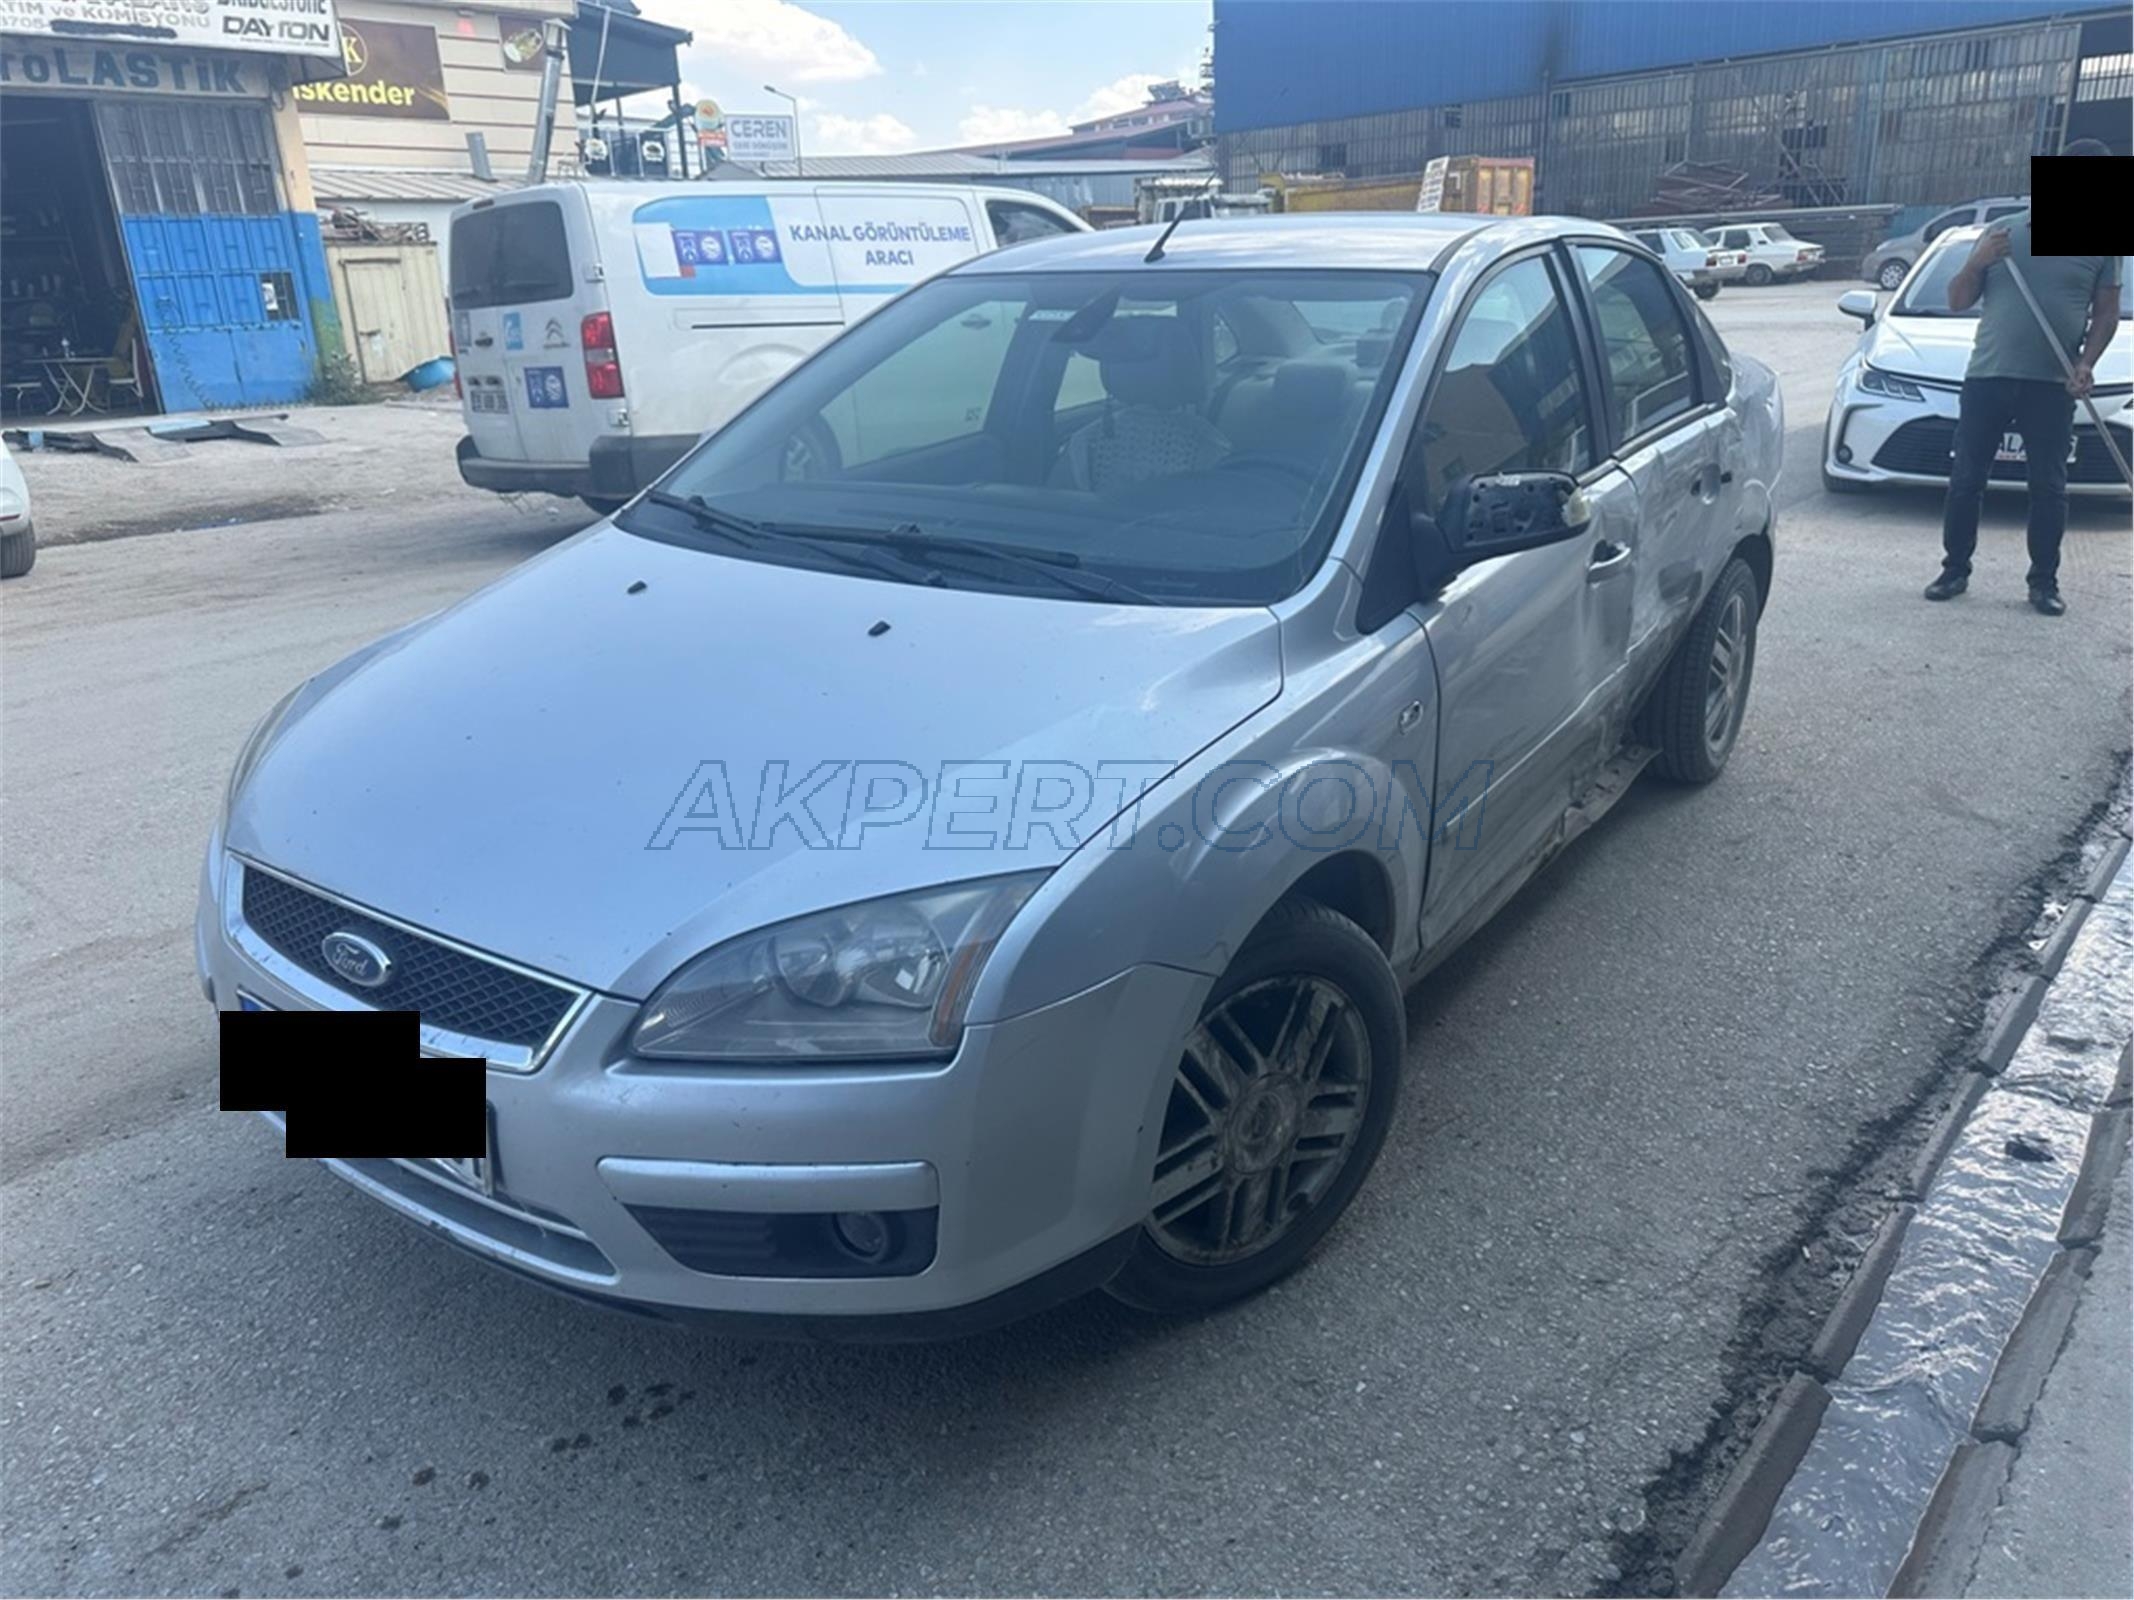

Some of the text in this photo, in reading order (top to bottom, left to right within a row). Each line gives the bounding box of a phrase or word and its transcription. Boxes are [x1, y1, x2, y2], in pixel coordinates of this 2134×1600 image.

[223, 15, 330, 41] DAYTON
[730, 120, 787, 138] CEREN
[789, 220, 971, 242] KANAL GÖRÜNTÜLEME
[865, 249, 914, 266] ARACI
[332, 943, 369, 977] Ford
